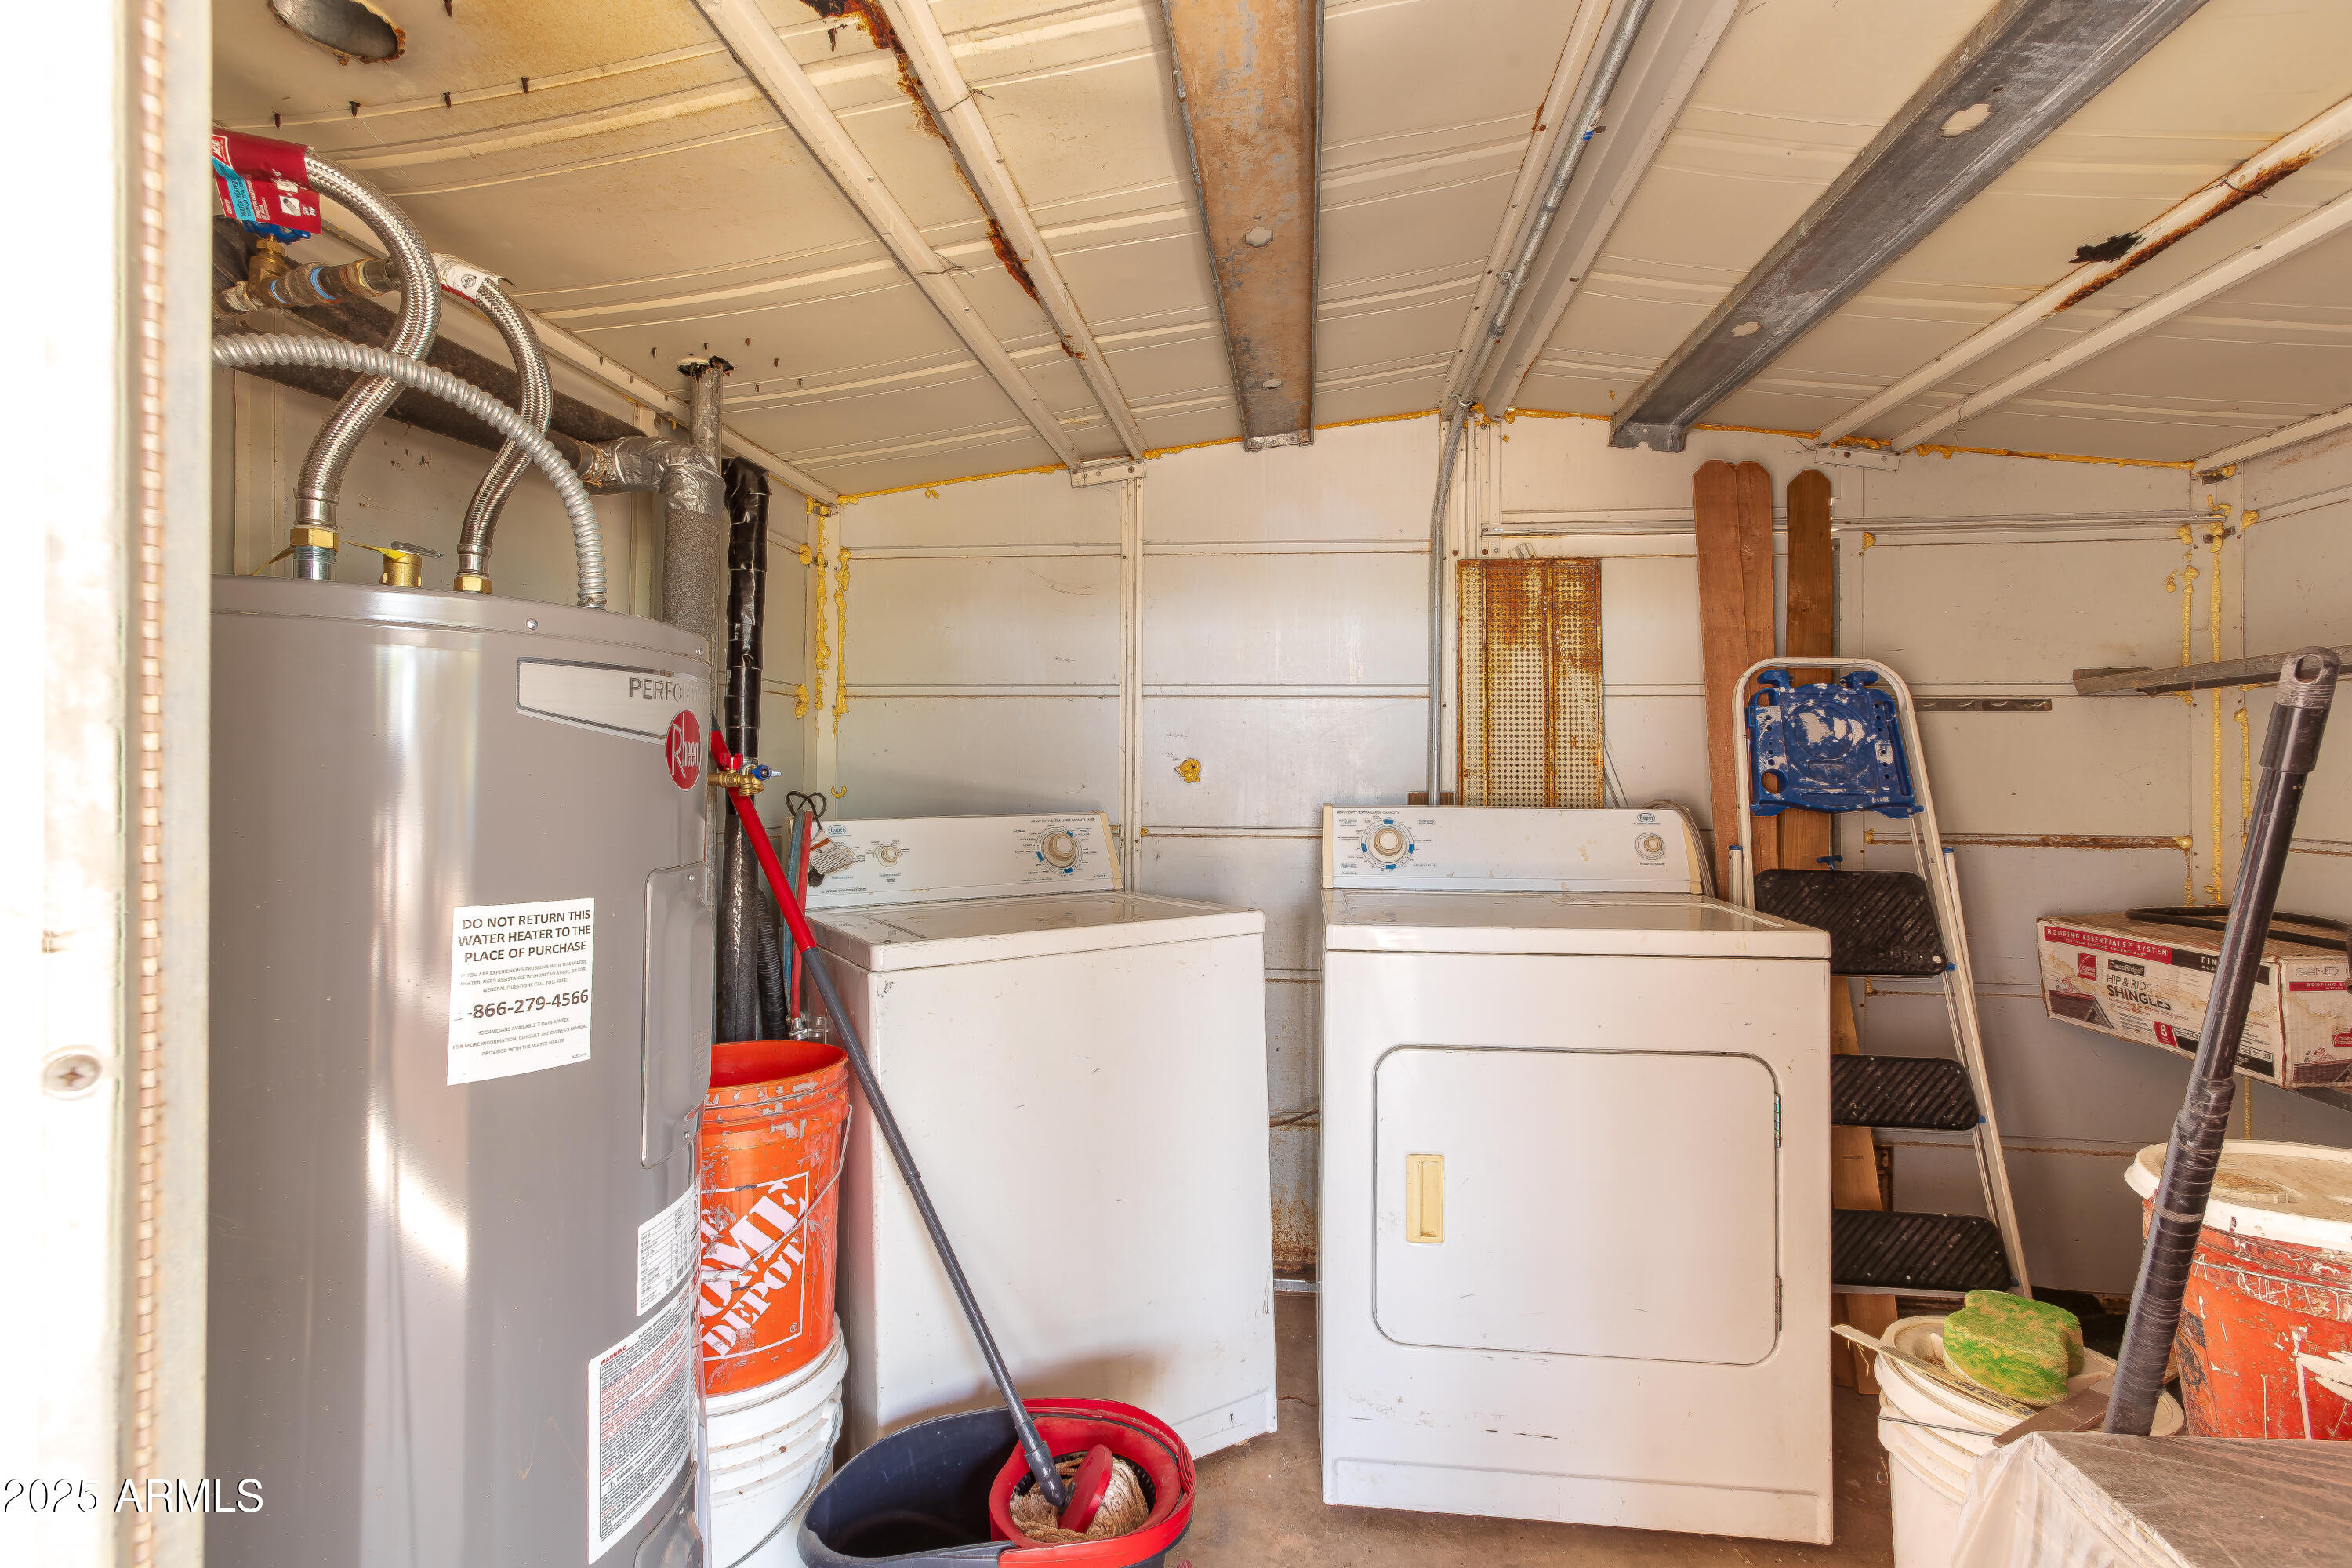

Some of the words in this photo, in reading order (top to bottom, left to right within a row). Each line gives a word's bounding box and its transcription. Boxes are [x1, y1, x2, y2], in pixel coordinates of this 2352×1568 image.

[671, 712, 702, 778] Rheem
[463, 919, 483, 929] DO
[487, 916, 514, 928] NOT
[518, 913, 564, 925] RETURN
[568, 910, 590, 920] THIS
[458, 933, 505, 946] WATER
[509, 930, 552, 942] HEATER
[556, 927, 570, 937] TO
[572, 925, 590, 935] THE
[2047, 928, 2080, 939] ROOFING
[2136, 944, 2168, 956] SYSTEM
[464, 949, 504, 963] PLACE
[508, 948, 525, 958] OF
[528, 941, 586, 956] PURCHASE
[2107, 973, 2121, 985] HIP
[2122, 978, 2129, 987] &
[2296, 967, 2339, 977] SAND
[2107, 985, 2171, 1011] SHINGLES
[2160, 1024, 2168, 1036] 8
[481, 1036, 517, 1046] INFORMATION,
[601, 1345, 627, 1366] WARNING
